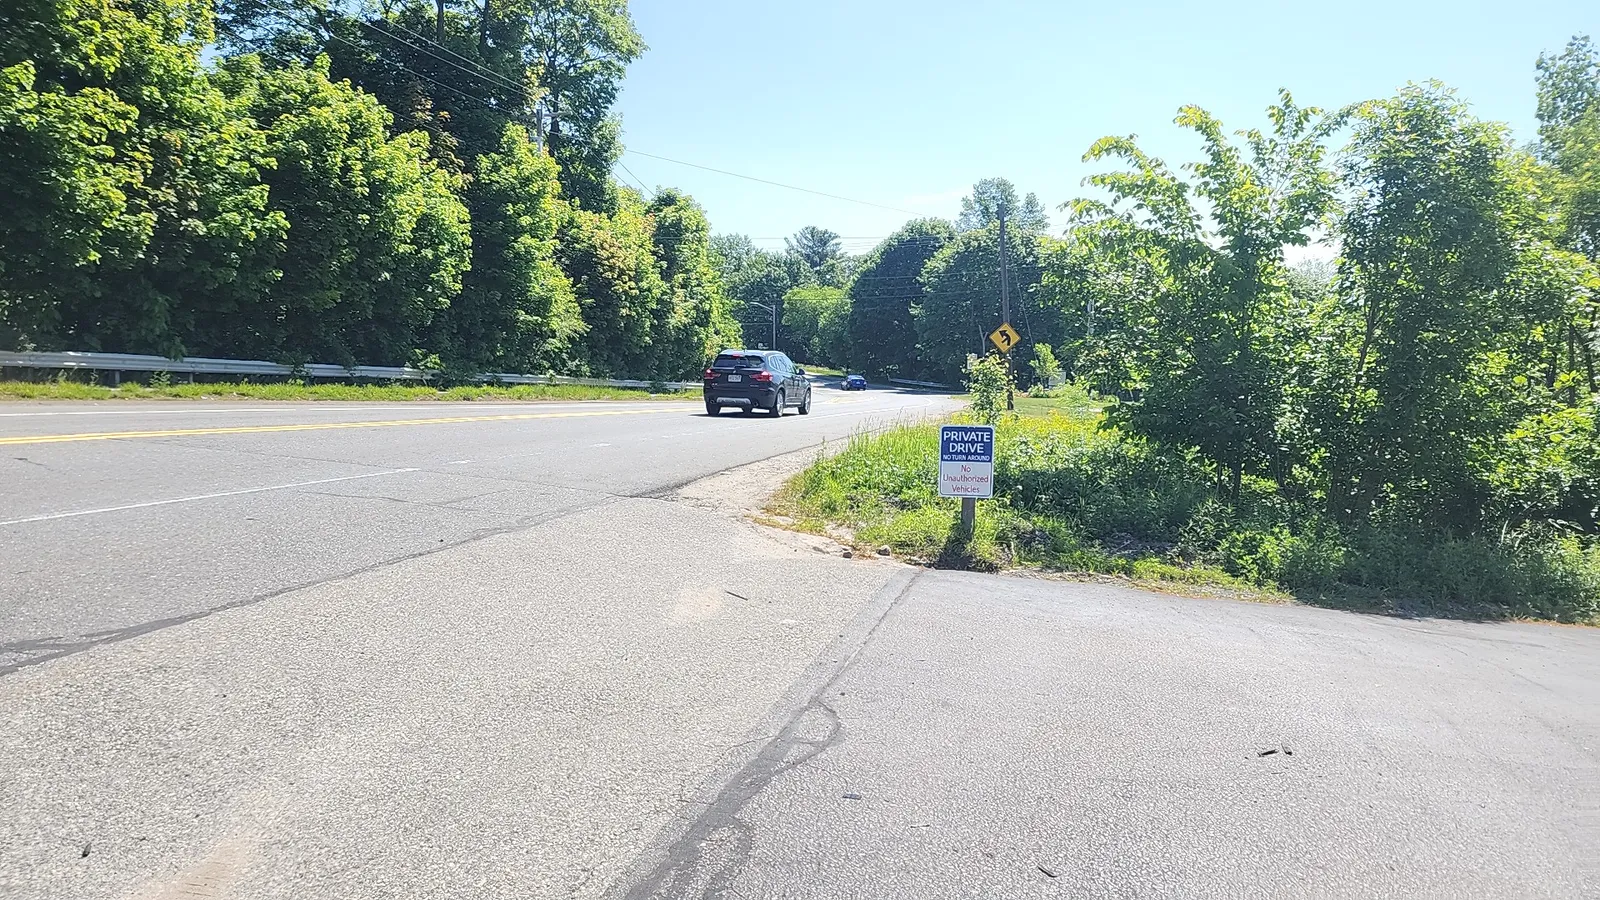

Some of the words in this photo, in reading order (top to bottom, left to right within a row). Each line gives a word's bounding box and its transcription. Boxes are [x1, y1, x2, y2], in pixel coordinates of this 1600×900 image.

[943, 431, 991, 442] PRIVATE
[949, 442, 984, 453] DRIVE
[961, 464, 971, 473] No
[943, 473, 989, 483] Unauthorized
[951, 484, 980, 493] Vehicles
